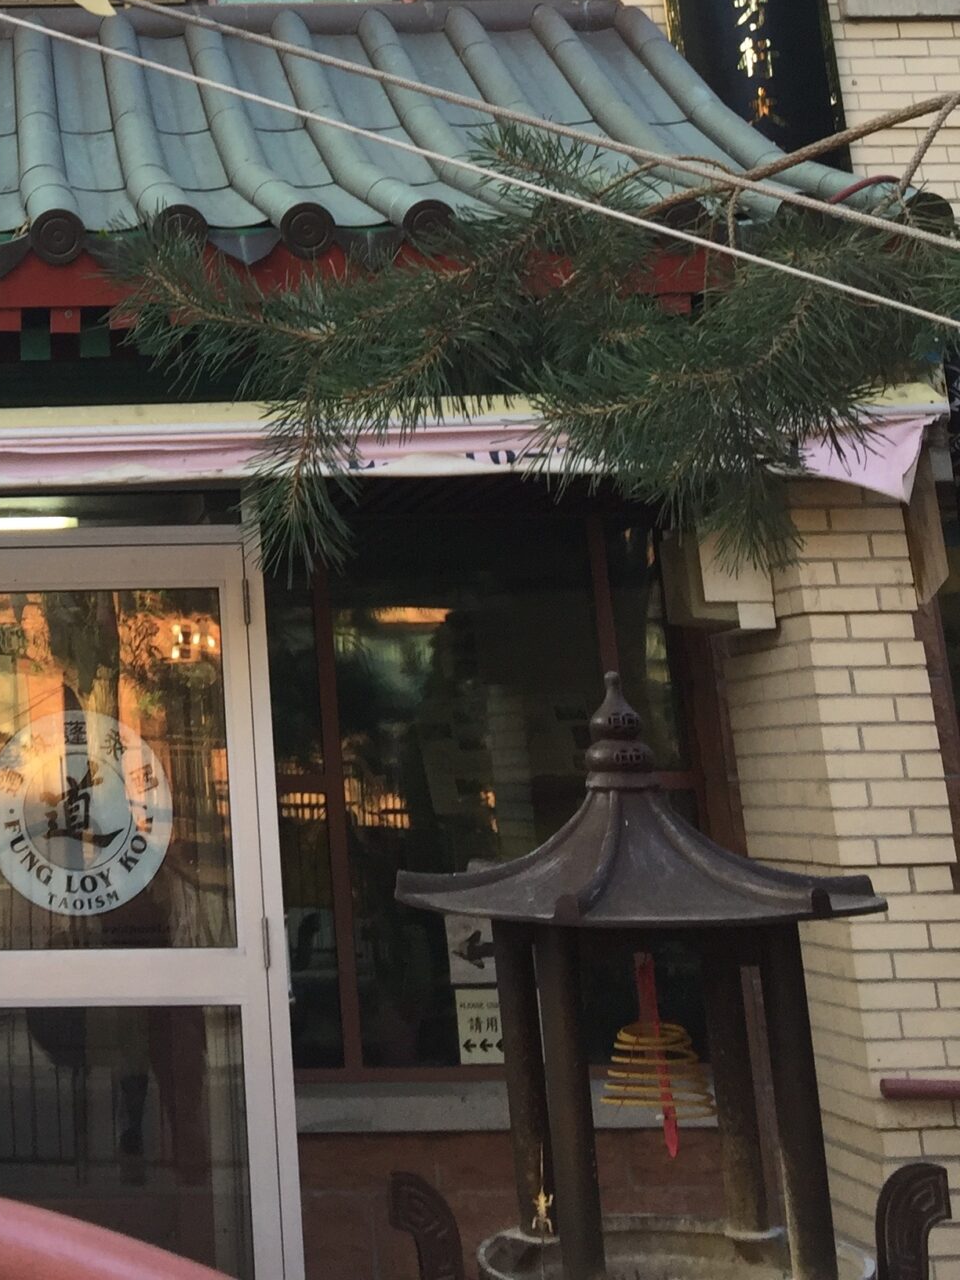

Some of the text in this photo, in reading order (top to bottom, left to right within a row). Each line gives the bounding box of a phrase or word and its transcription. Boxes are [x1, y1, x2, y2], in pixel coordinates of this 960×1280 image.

[40, 759, 125, 849] 道
[4, 814, 154, 894] FUNG LOY KOK
[47, 890, 120, 911] TAOISM
